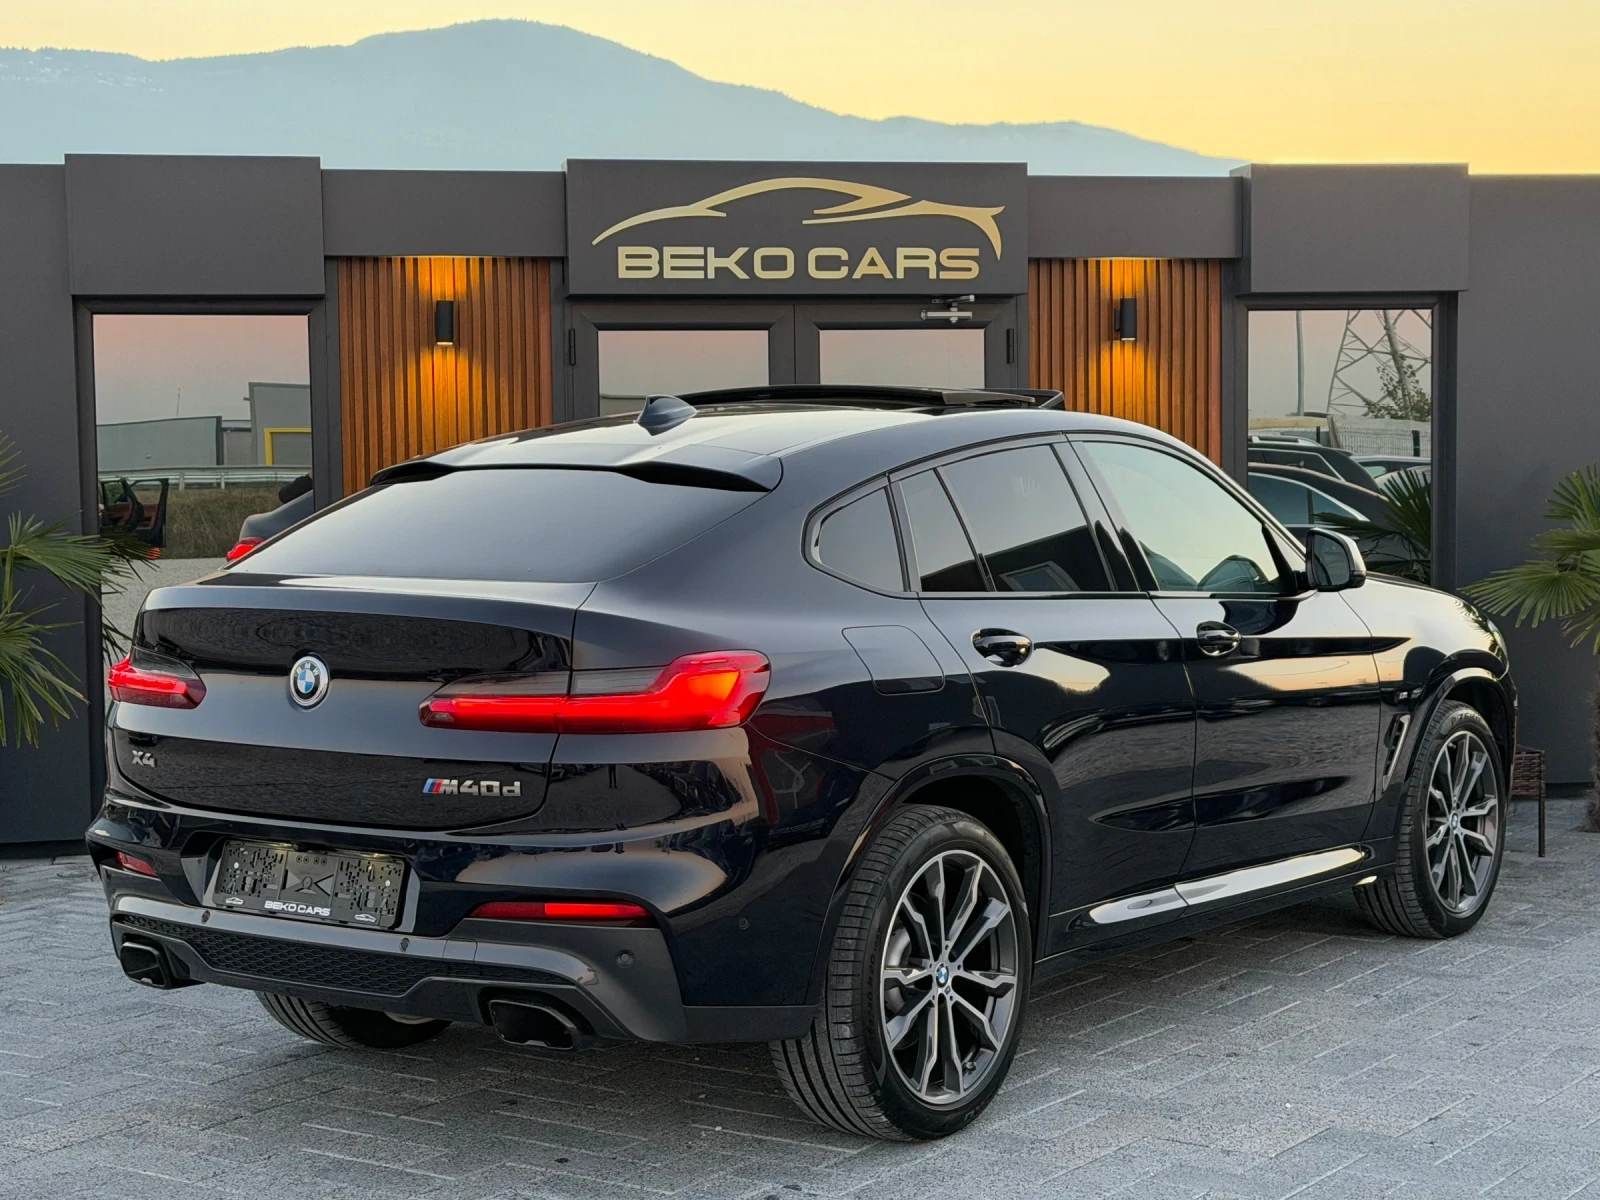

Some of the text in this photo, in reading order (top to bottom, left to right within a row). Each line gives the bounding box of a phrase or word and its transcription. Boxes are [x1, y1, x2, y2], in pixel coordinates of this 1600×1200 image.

[617, 246, 980, 280] BEKO CARS
[131, 750, 156, 768] X4
[424, 778, 521, 796] M40d
[264, 900, 331, 917] BEKO CARS
